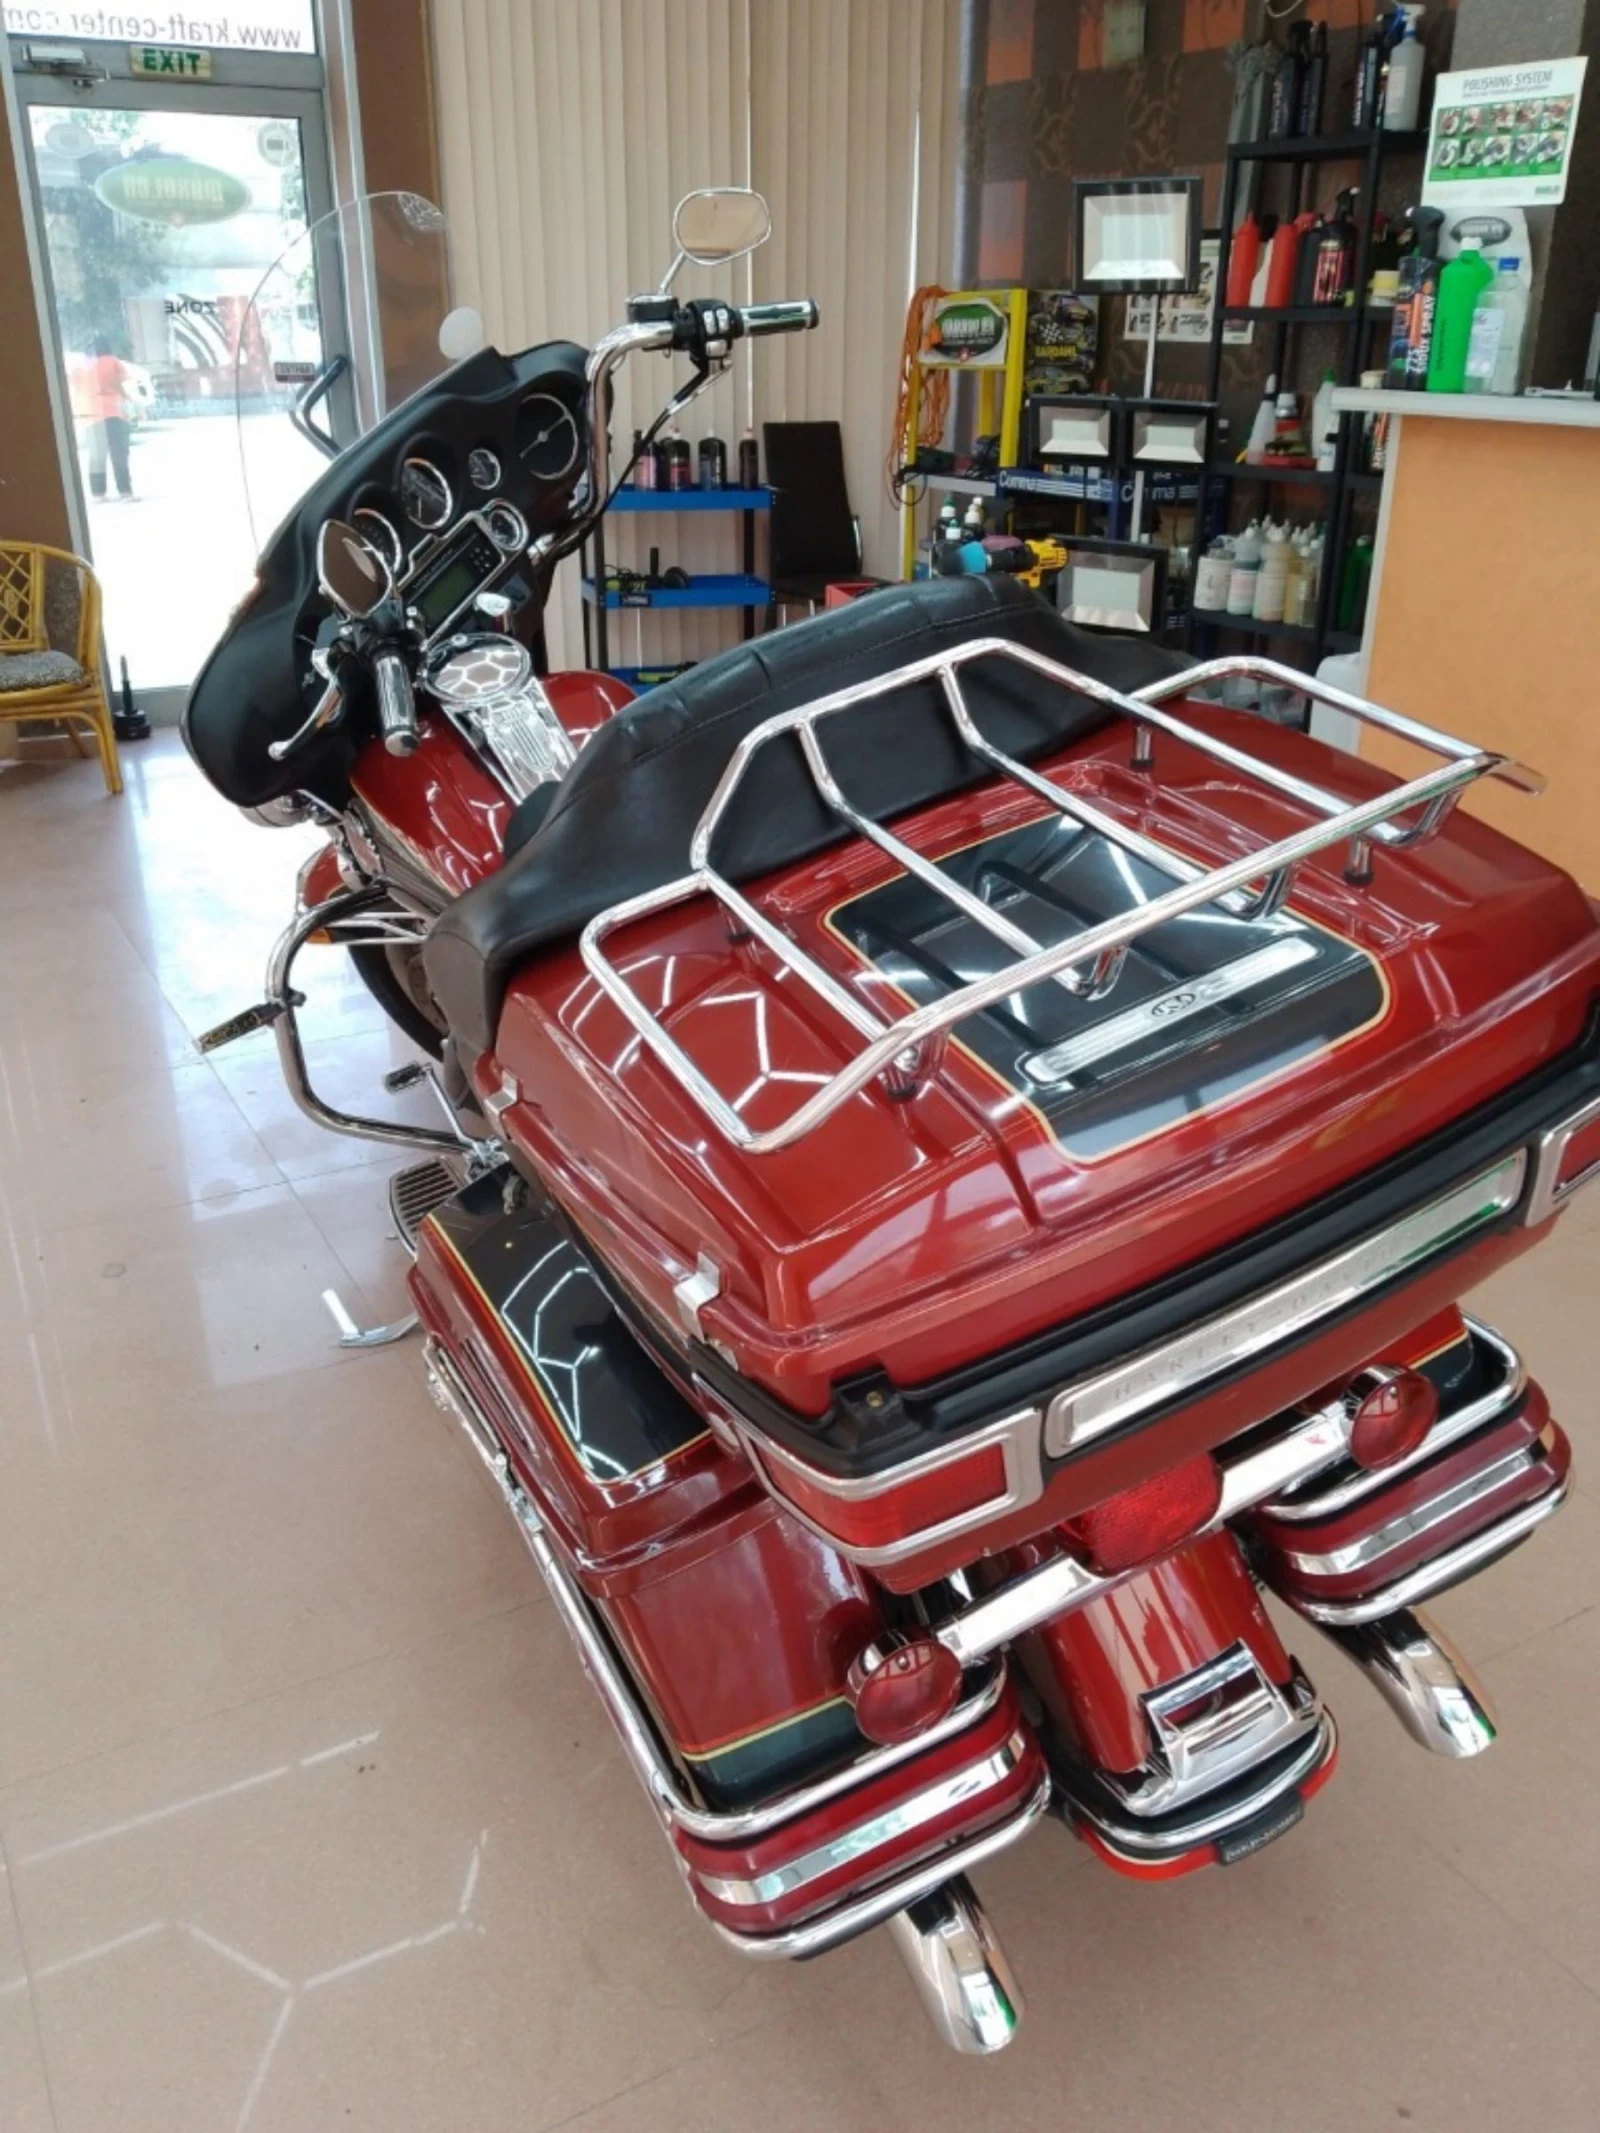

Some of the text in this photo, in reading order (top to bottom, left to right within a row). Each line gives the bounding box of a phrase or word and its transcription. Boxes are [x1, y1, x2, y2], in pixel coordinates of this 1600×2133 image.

[142, 48, 201, 75] EXIT
[1515, 69, 1553, 87] SYSTEM
[1120, 483, 1175, 502] Cma
